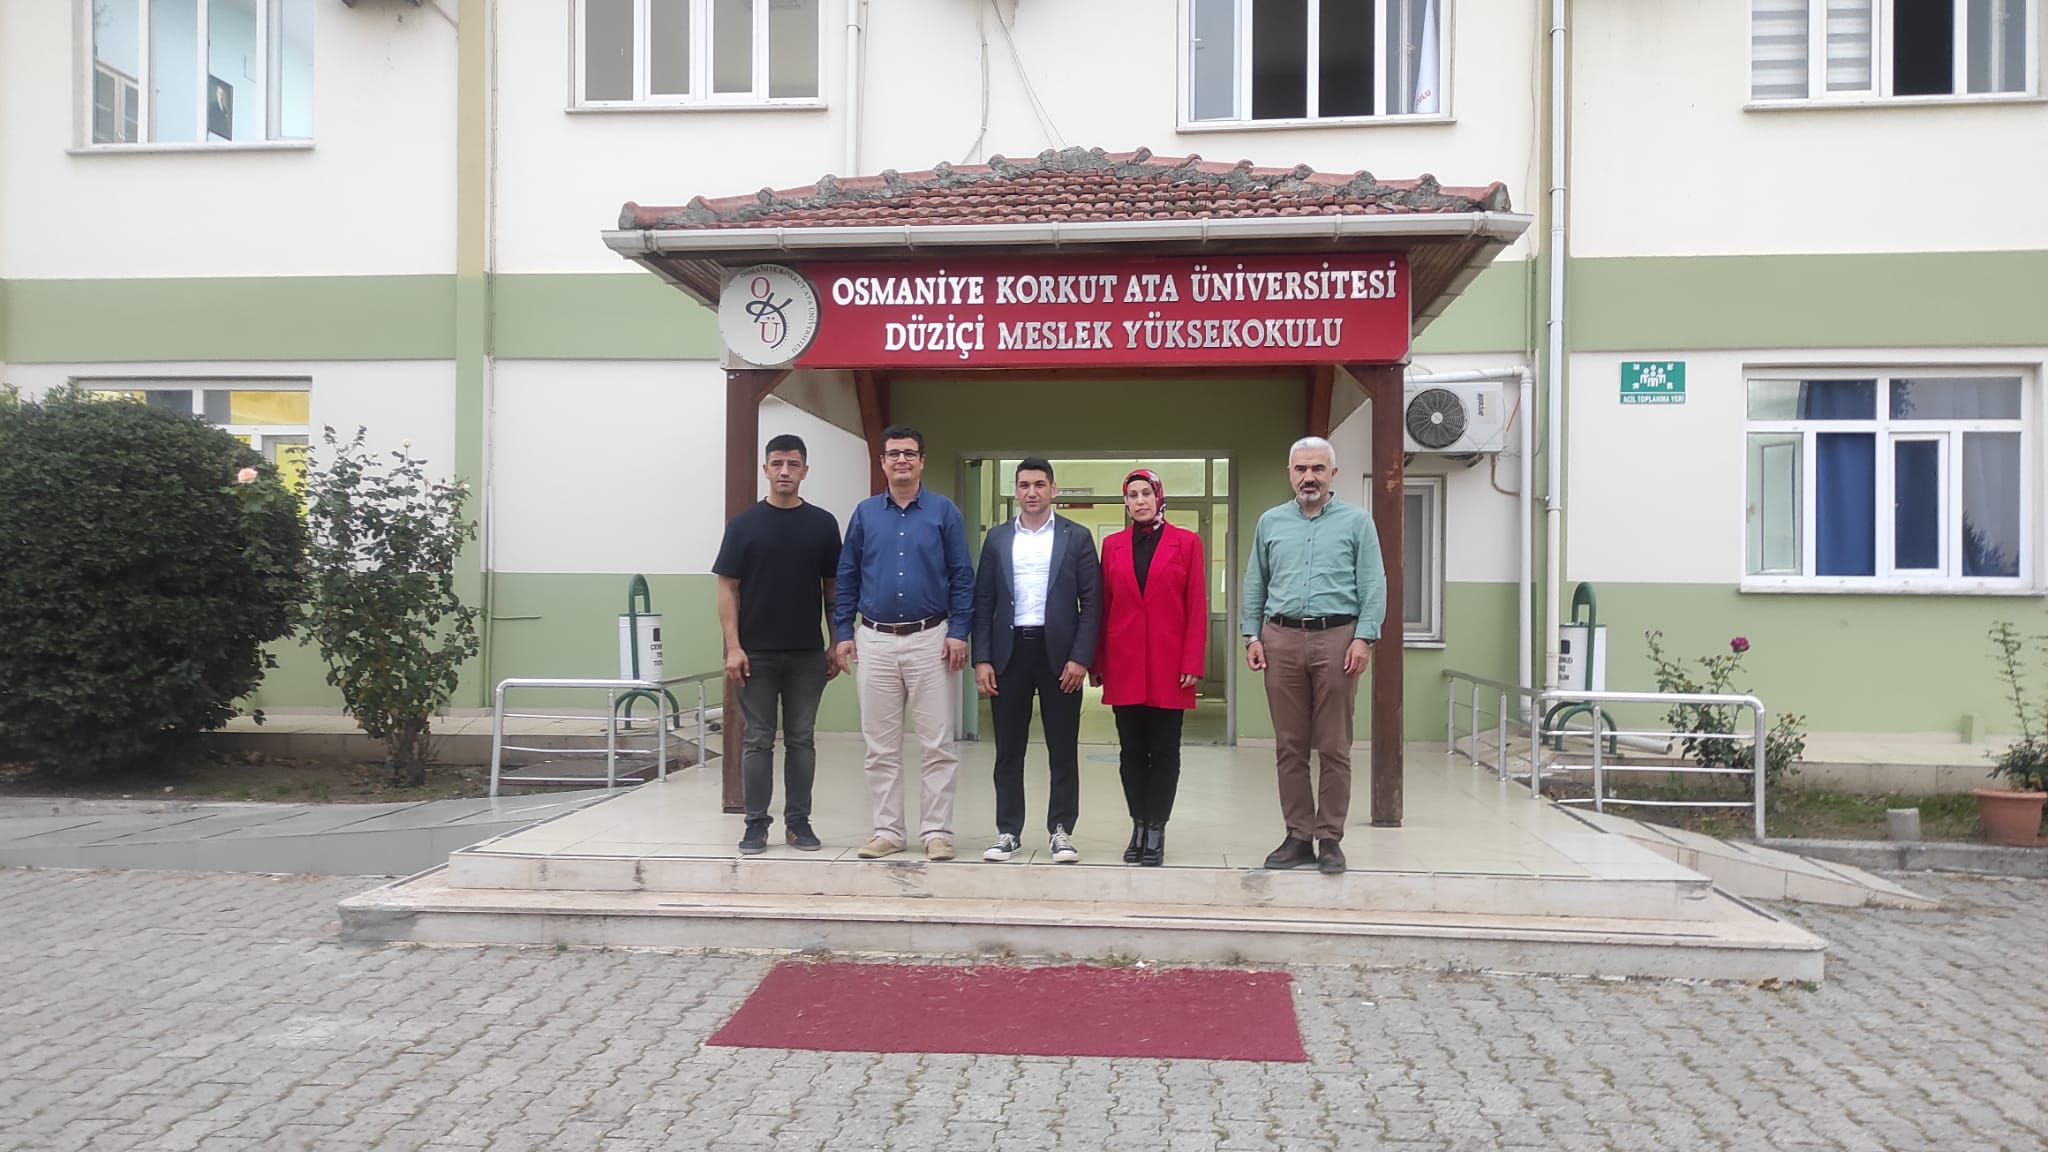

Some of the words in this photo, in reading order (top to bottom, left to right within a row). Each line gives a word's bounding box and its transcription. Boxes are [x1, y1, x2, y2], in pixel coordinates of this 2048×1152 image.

[832, 270, 985, 306] OSMANİYE
[996, 275, 1117, 304] KORKUT
[1123, 274, 1179, 302] ATA
[1190, 261, 1397, 302] ÜNİVERSİTESİ
[884, 314, 985, 359] DÜZİÇİ
[997, 321, 1113, 350] MESLEK
[1122, 312, 1344, 348] YÜKSEKOKULU
